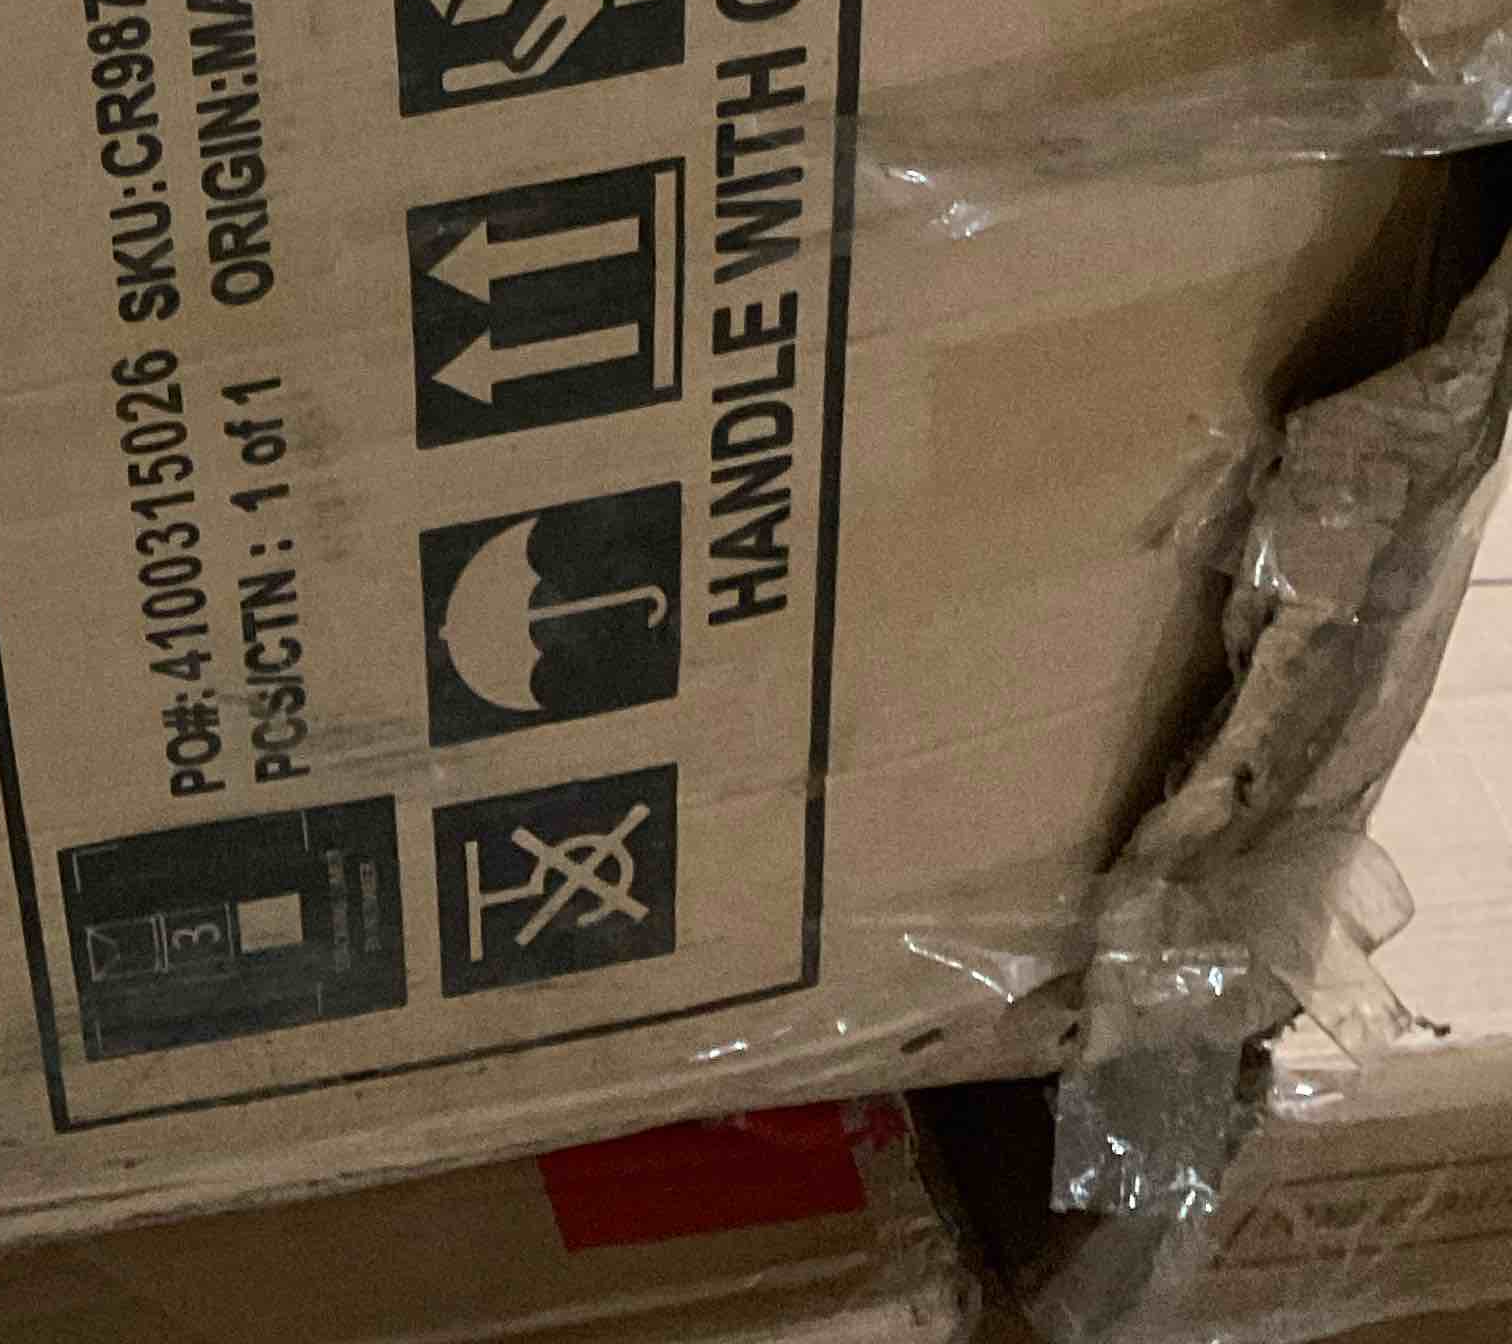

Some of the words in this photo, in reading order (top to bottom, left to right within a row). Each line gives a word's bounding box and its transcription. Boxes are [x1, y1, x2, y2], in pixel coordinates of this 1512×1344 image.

[712, 45, 809, 284] WITH
[220, 374, 281, 406] 1
[222, 416, 287, 465] of
[706, 291, 799, 627] HANDLE
[228, 481, 291, 513] 1
[171, 922, 222, 951] 3
